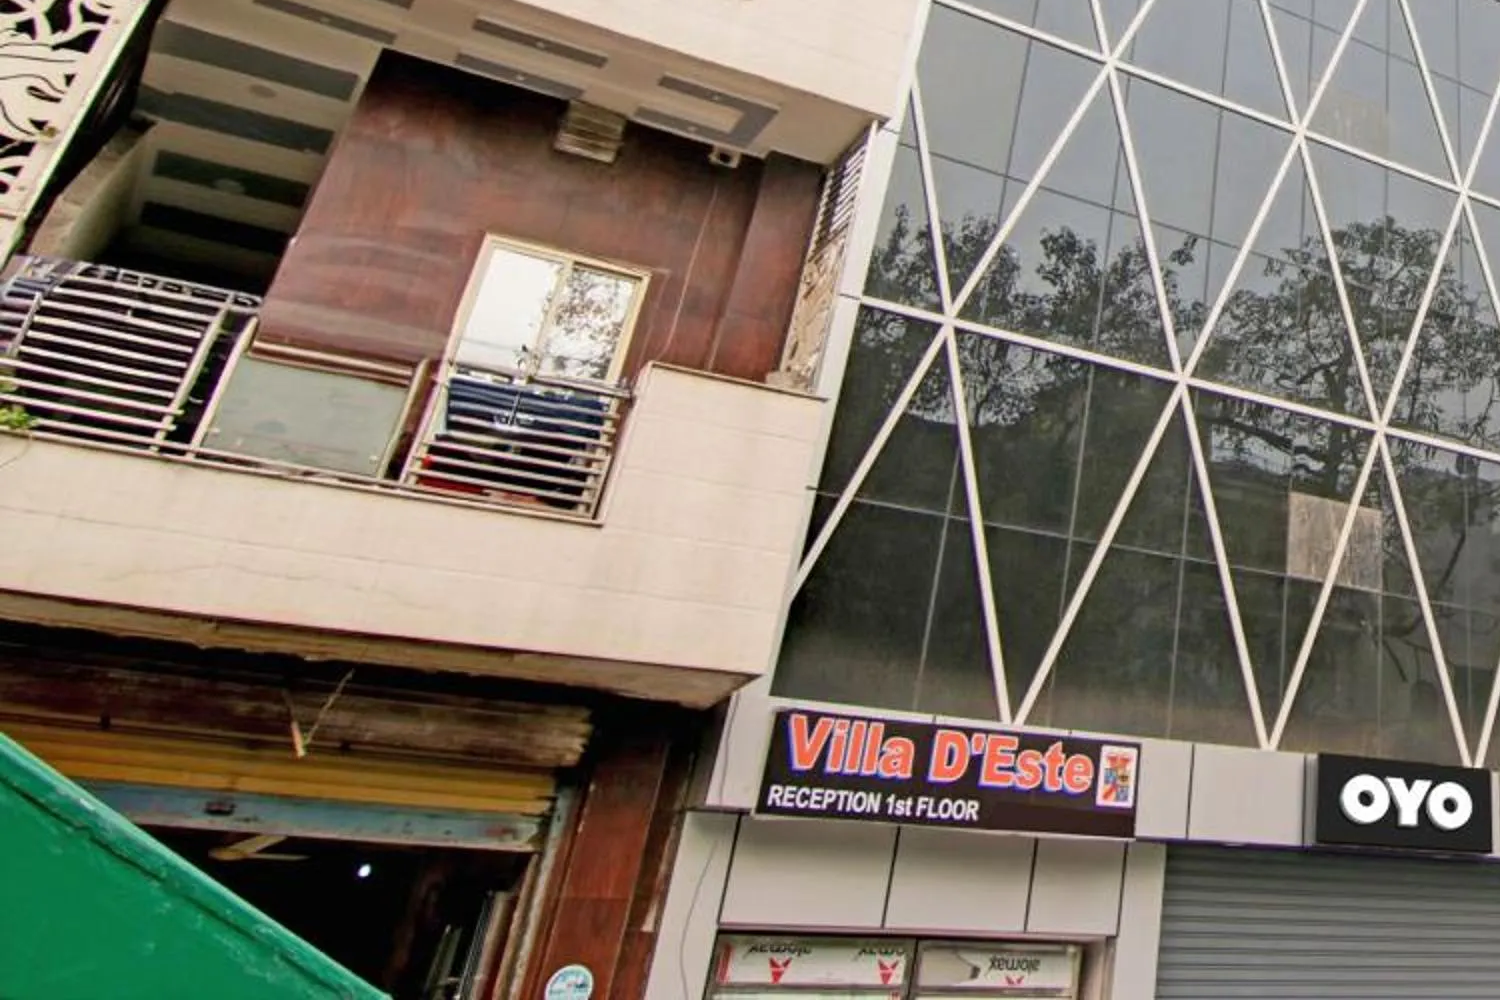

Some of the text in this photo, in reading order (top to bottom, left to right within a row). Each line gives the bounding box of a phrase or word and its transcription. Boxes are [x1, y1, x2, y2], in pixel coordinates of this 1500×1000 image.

[788, 713, 1095, 796] Villa D'Este
[767, 785, 979, 821] RECEPTION 1st FLOOR
[1340, 774, 1473, 831] OYO
